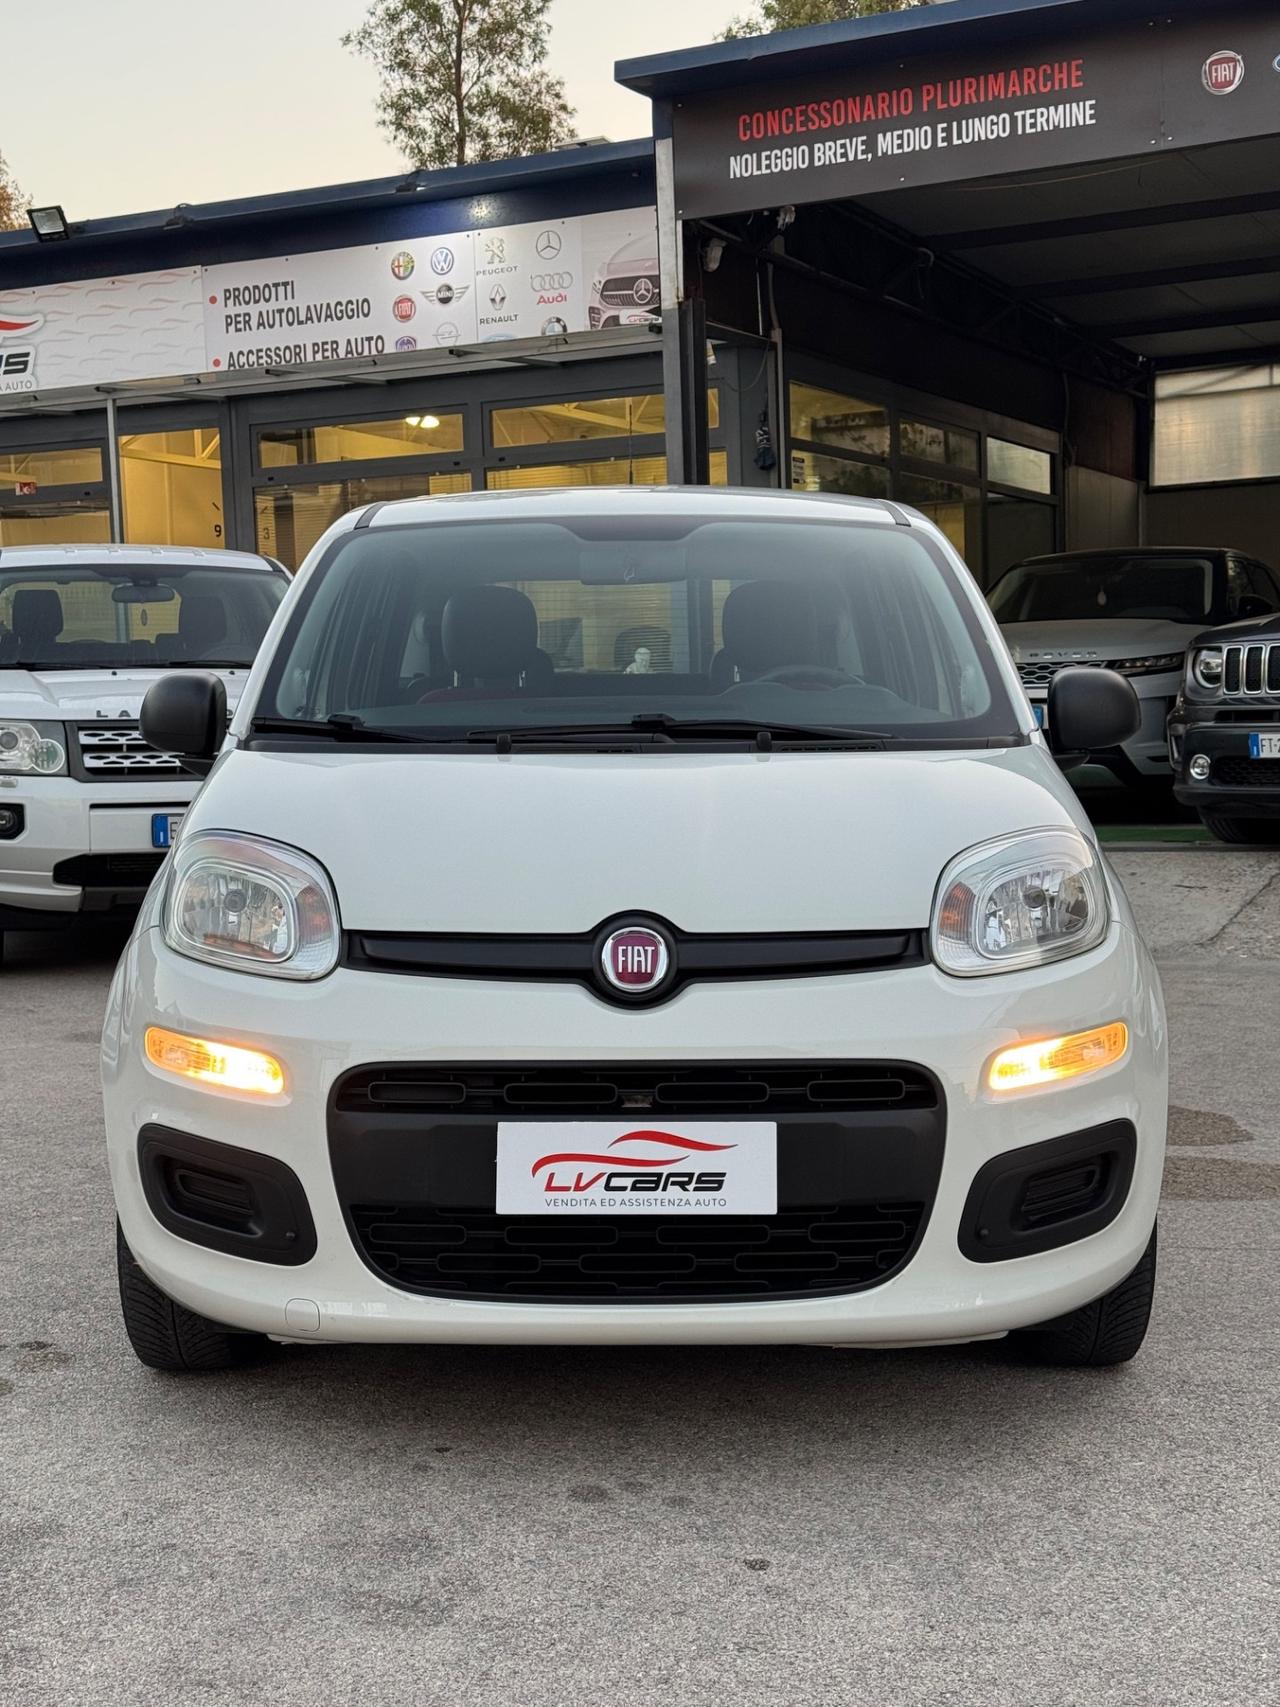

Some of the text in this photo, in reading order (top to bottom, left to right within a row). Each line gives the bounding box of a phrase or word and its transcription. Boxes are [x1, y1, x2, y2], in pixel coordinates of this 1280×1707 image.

[1211, 62, 1235, 83] FIAT
[738, 59, 1083, 141] CONCESSONARIO PLURIMARCHE
[729, 100, 1096, 179] NOLEGGIO BREVE, MEDIO E LUNGO TERMINE
[476, 265, 518, 276] PEUGEOT
[223, 280, 295, 308] PRODOTTI
[225, 298, 371, 334] PER AUTOLAVAGGIO
[480, 314, 519, 325] RENAULT
[227, 335, 385, 370] ACCESSORI PER AUTO
[5, 380, 33, 391] AUTO
[214, 524, 222, 537] 9
[618, 946, 655, 973] FIAT
[545, 1198, 727, 1207] VENDITA ED ASSISTENZA AUTO
